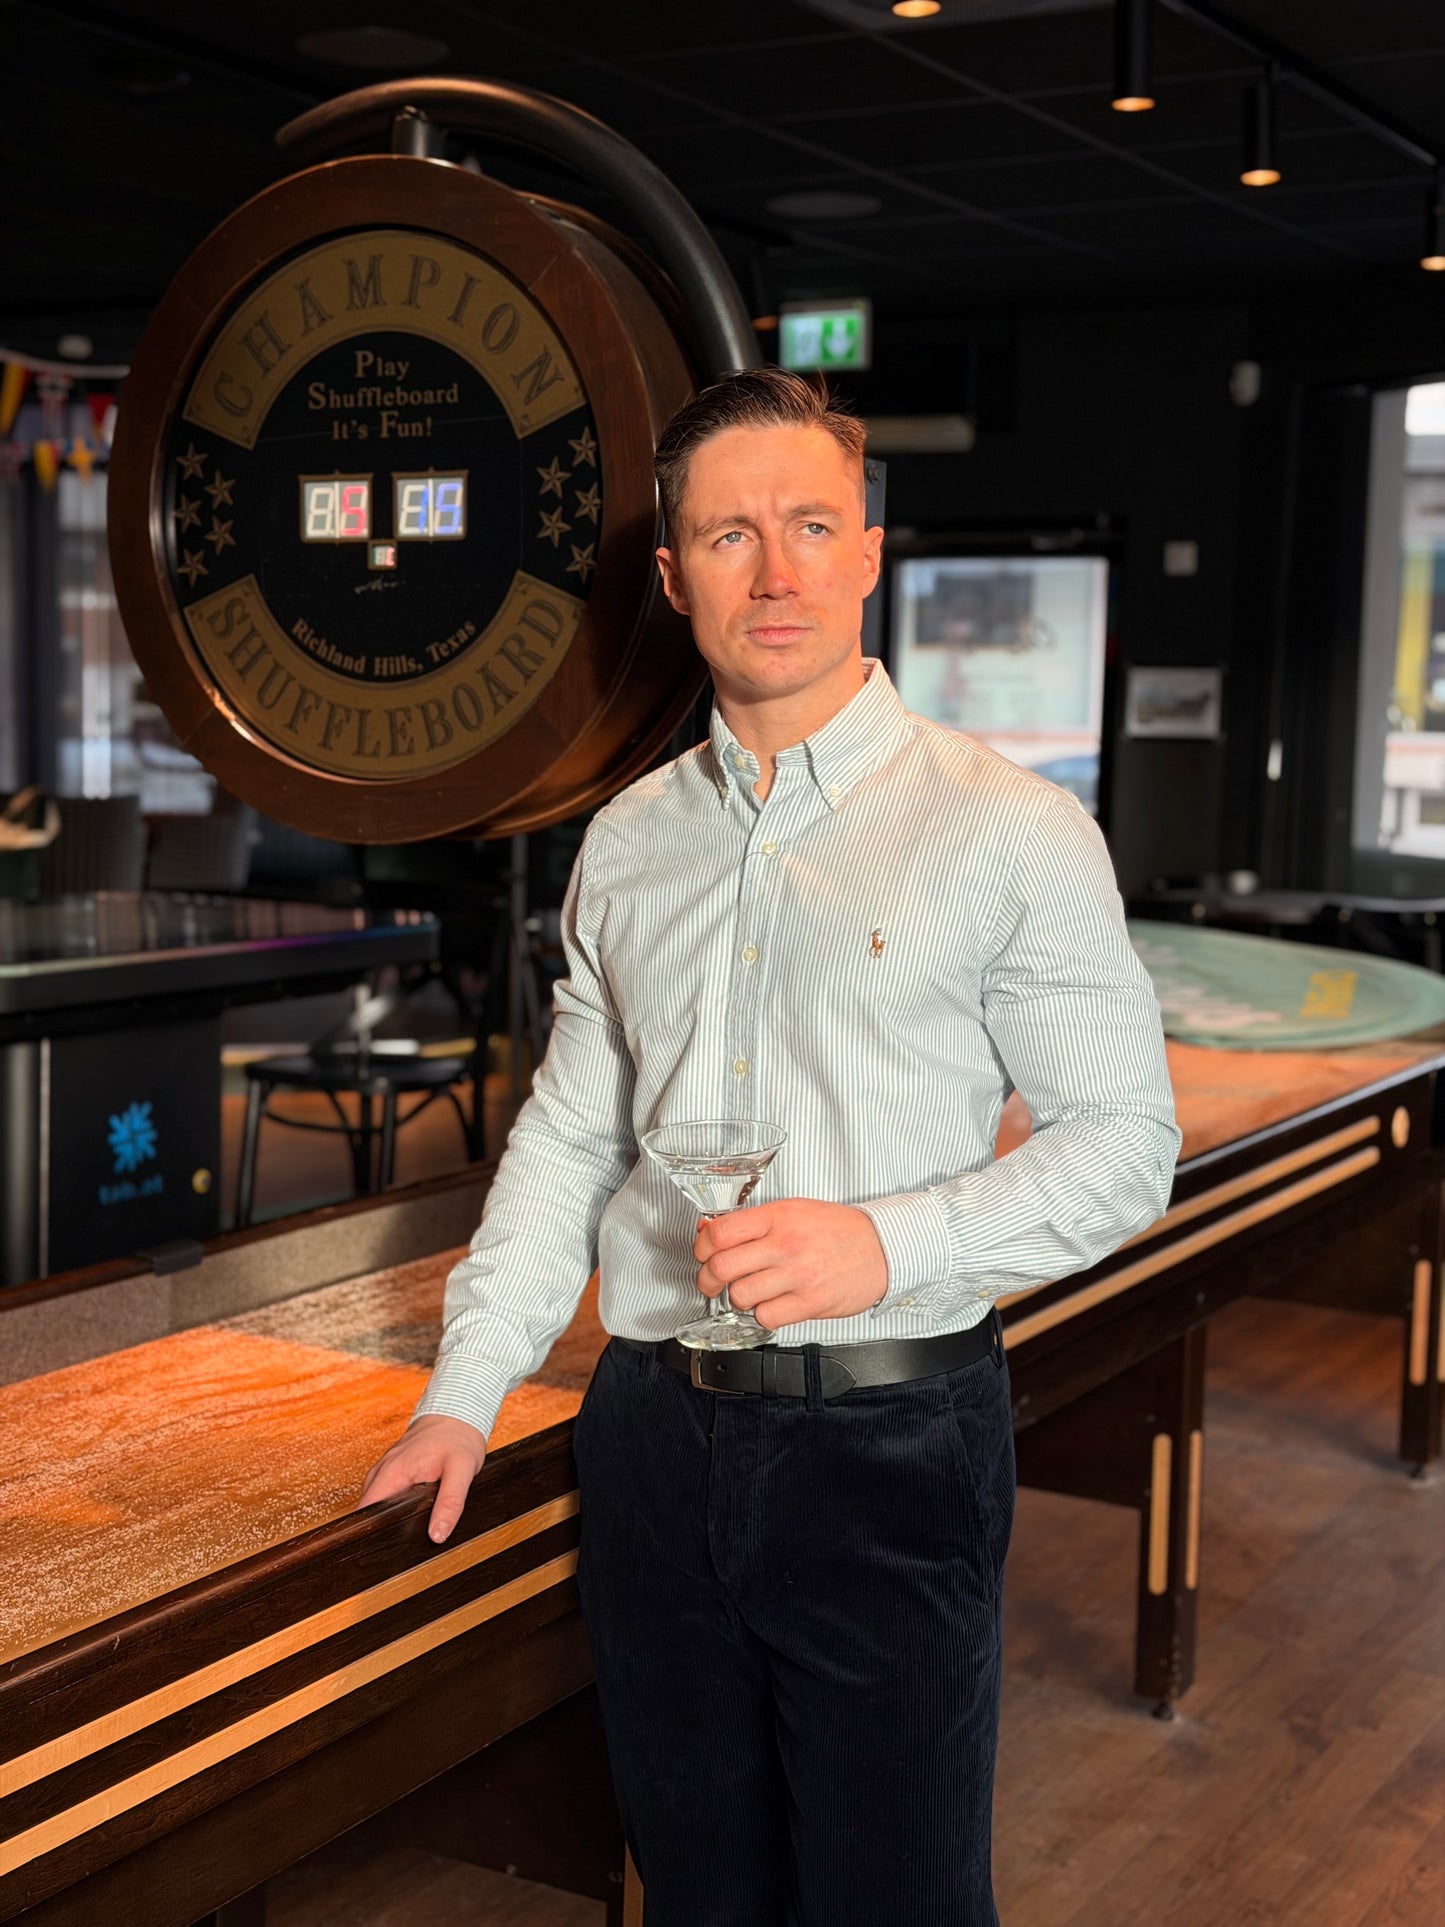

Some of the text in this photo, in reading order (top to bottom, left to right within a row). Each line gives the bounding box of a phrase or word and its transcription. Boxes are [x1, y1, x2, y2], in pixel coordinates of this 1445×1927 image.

[213, 253, 564, 418] CHAMPION
[354, 350, 410, 381] Play
[307, 382, 460, 410] Shuffleboard
[332, 410, 433, 440] It's Fun!
[291, 617, 476, 676] Richland Hills, Texas
[207, 597, 565, 758] SHUFFLEBOARD
